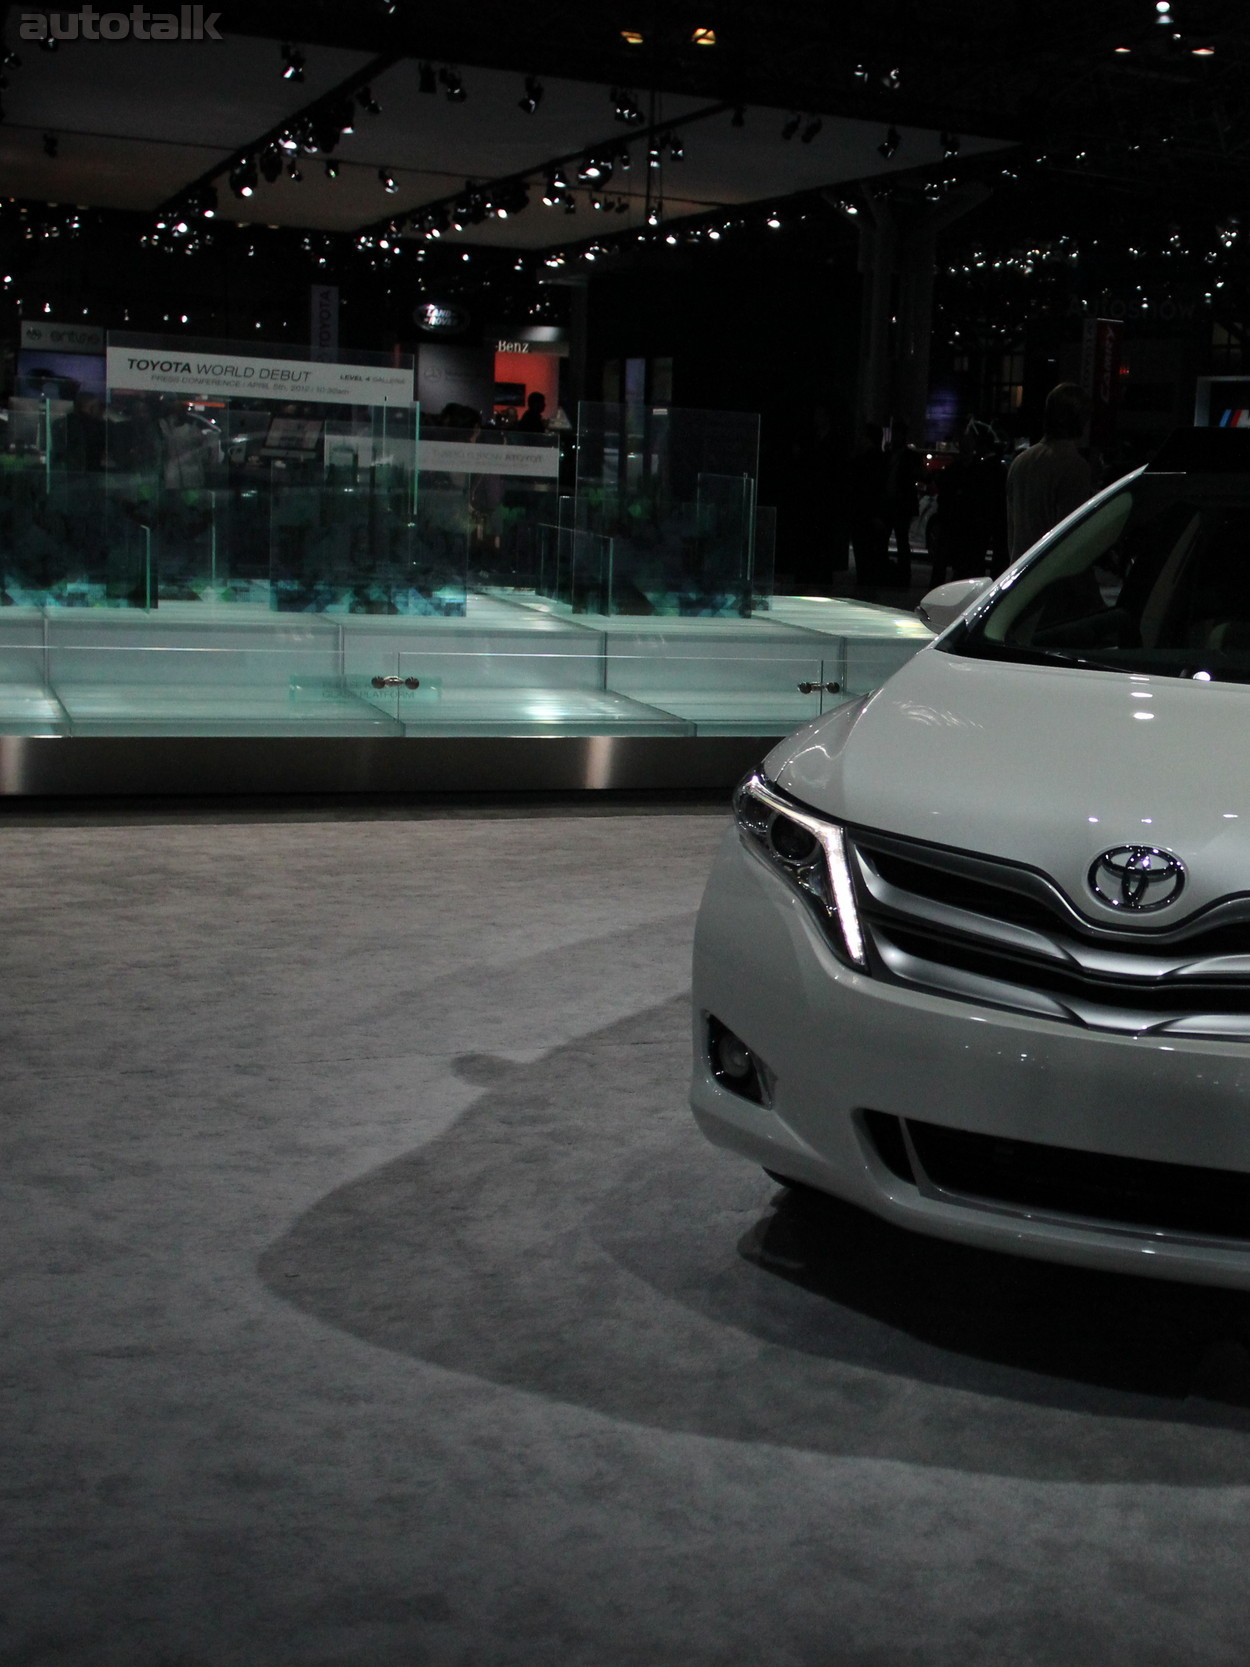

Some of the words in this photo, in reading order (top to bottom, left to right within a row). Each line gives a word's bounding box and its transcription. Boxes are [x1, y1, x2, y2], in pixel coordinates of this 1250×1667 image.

[319, 289, 332, 349] TOYOTA
[127, 358, 192, 374] TOYOTA
[196, 364, 255, 378] WORLD
[258, 367, 312, 382] DEBUT
[340, 374, 364, 382] LEVEL
